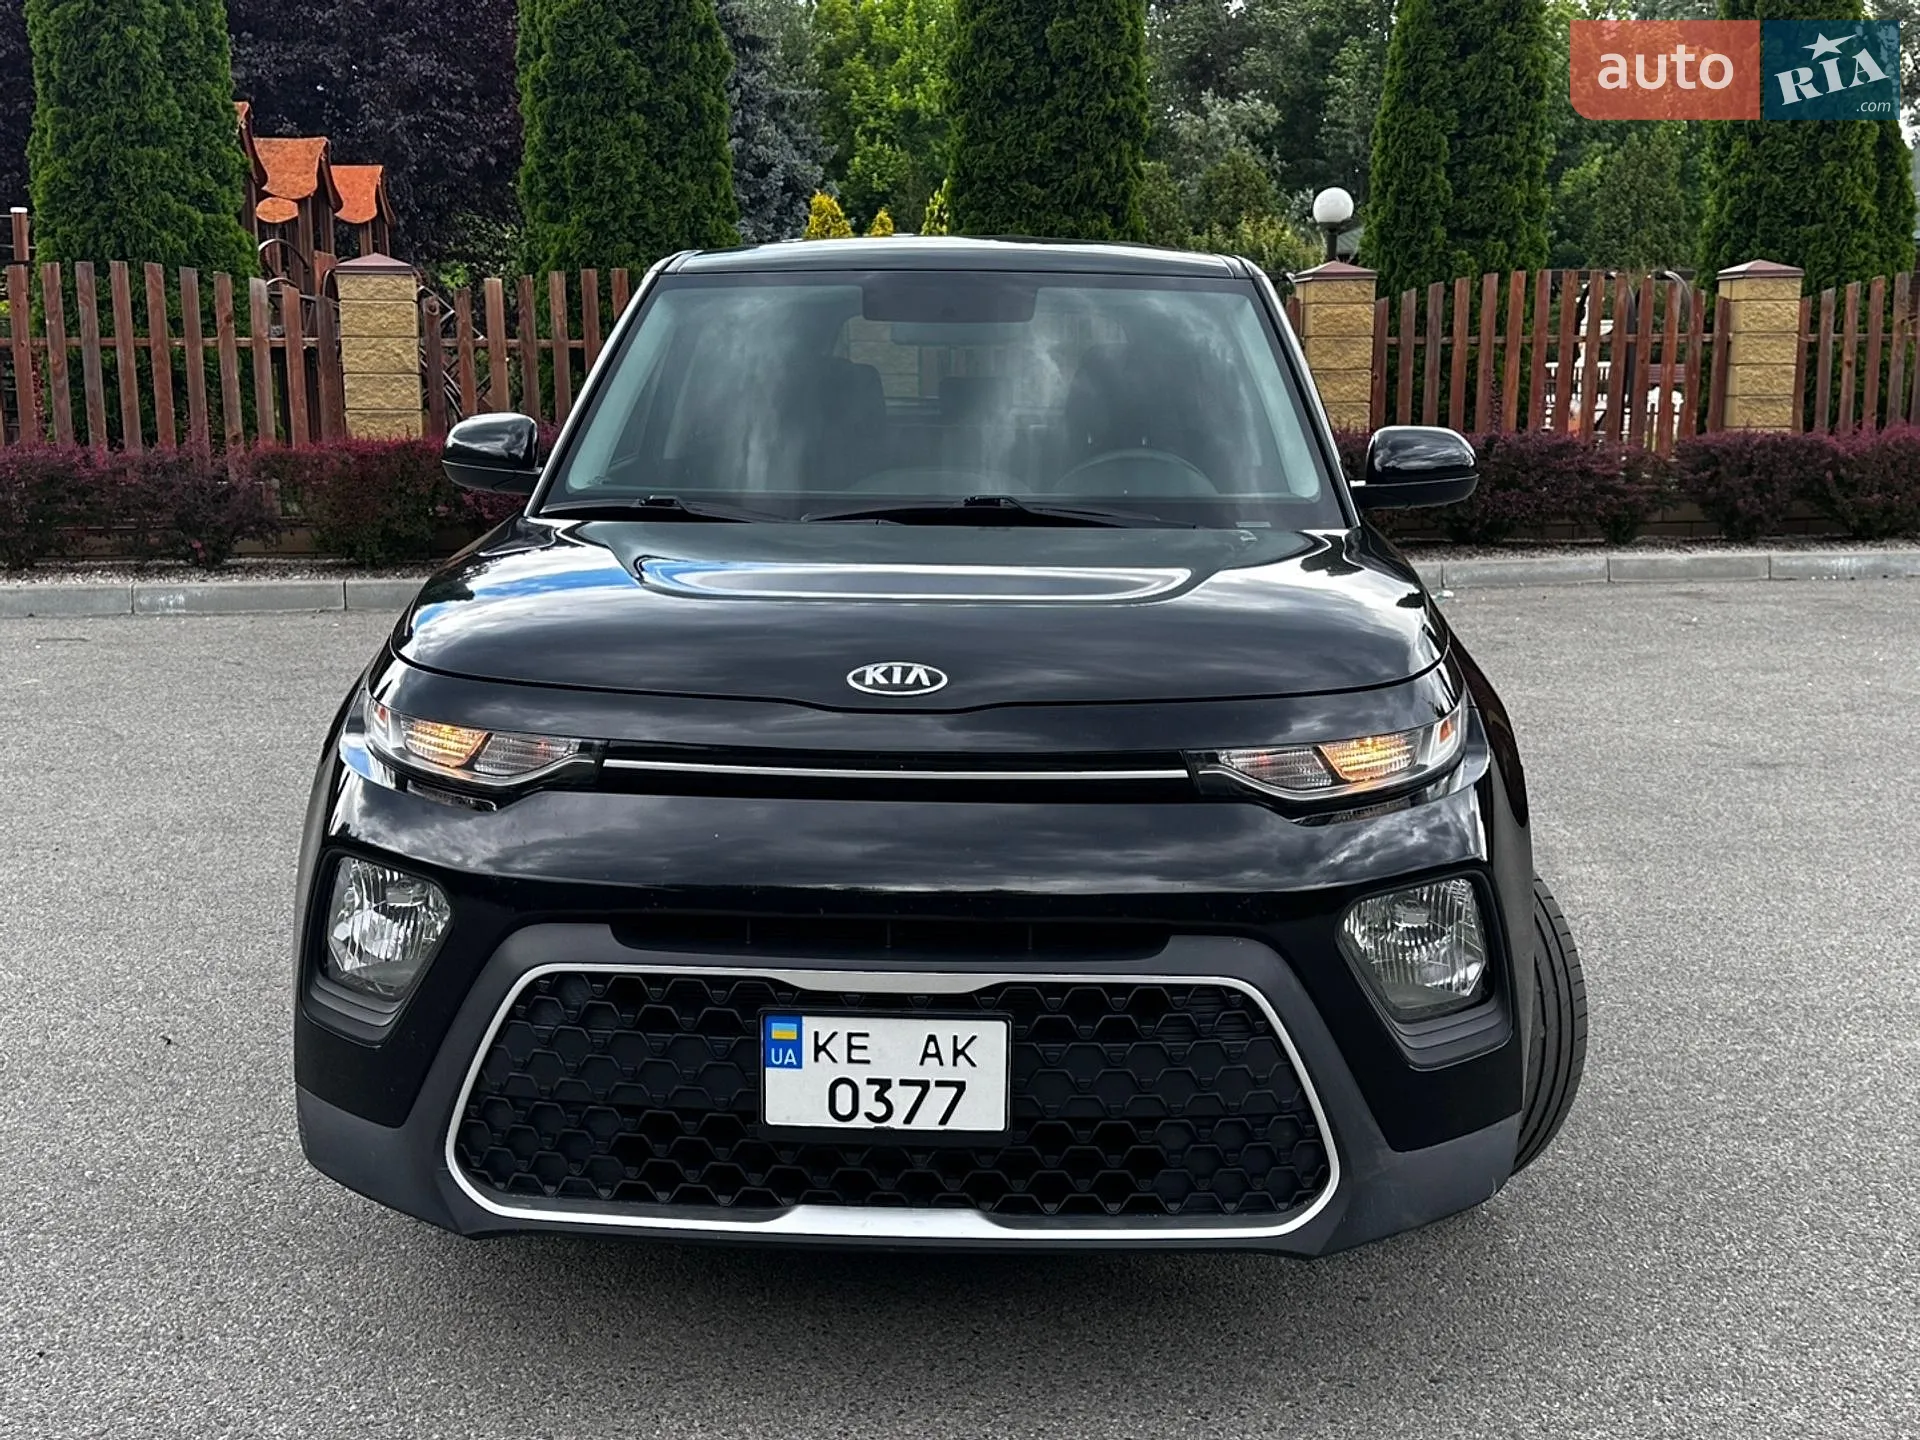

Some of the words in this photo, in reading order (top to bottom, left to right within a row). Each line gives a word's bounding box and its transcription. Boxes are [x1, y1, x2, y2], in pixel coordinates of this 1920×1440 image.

[864, 666, 931, 687] KIA
[771, 1048, 797, 1065] UA
[813, 1031, 871, 1065] KE
[919, 1034, 977, 1068] AK
[828, 1077, 967, 1126] 0377
